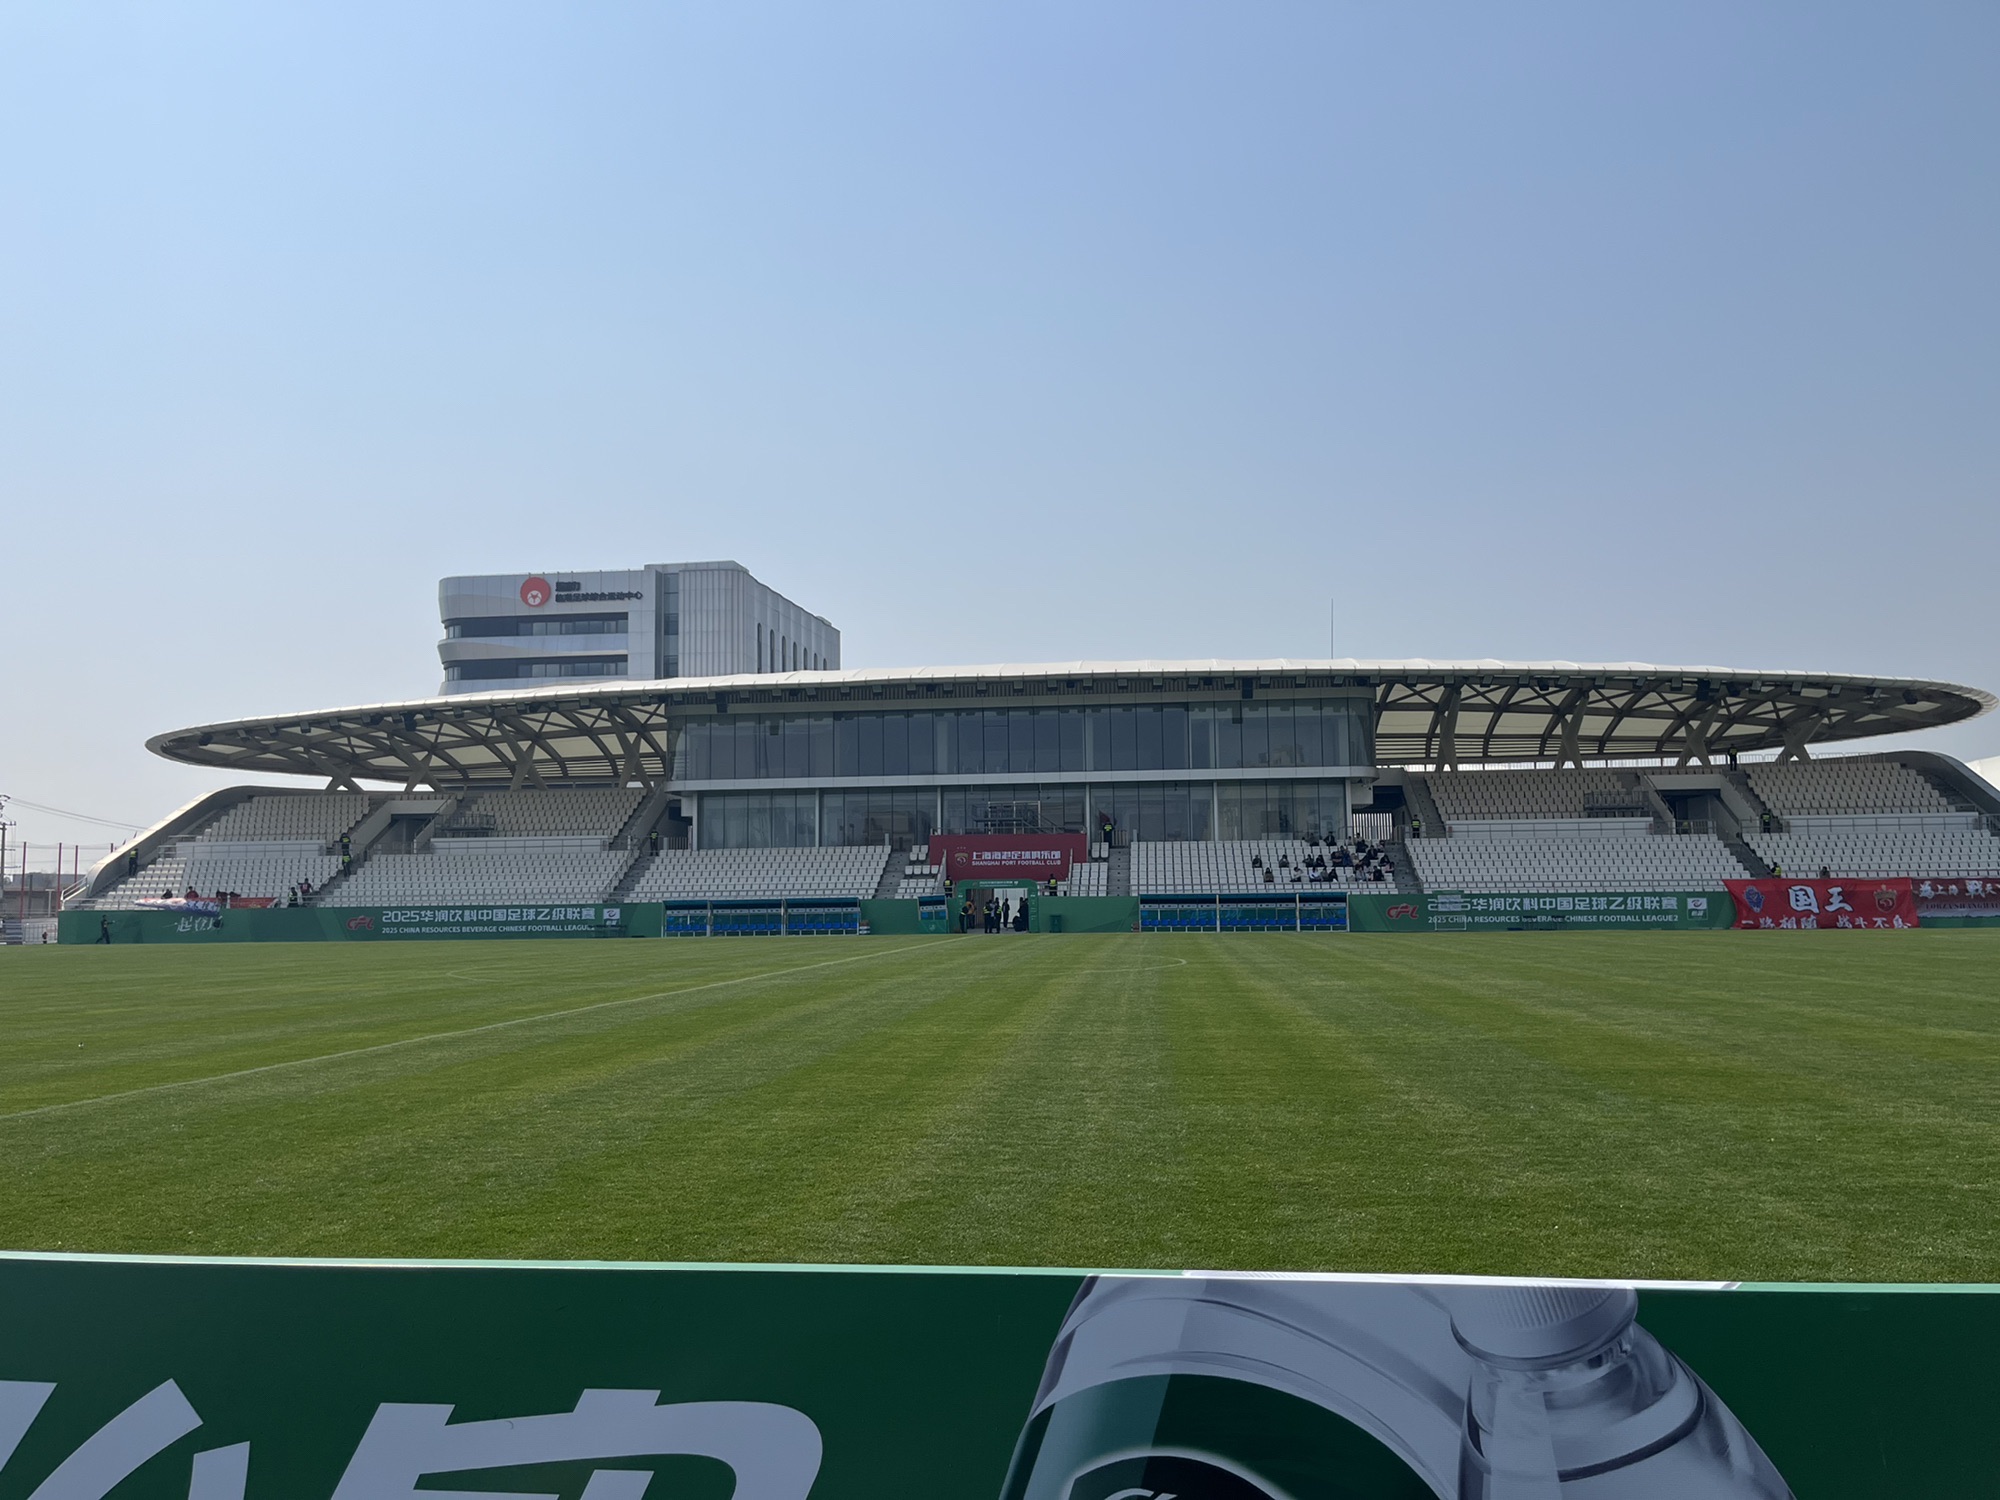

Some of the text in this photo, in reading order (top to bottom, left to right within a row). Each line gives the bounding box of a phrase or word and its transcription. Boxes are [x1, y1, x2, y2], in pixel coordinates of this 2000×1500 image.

[972, 851, 1061, 860] 上海海港足球俱乐部
[1428, 897, 1678, 911] 25华润饮料中国足球乙级联赛
[1788, 885, 1854, 914] 国王
[382, 907, 596, 923] 2025华润饮料中国足球乙级联赛
[1475, 915, 1520, 923] RESOURCES
[1600, 914, 1640, 922] FOOTBALL
[462, 925, 496, 933] BEVERAGE
[528, 924, 563, 932] FOOTBALL
